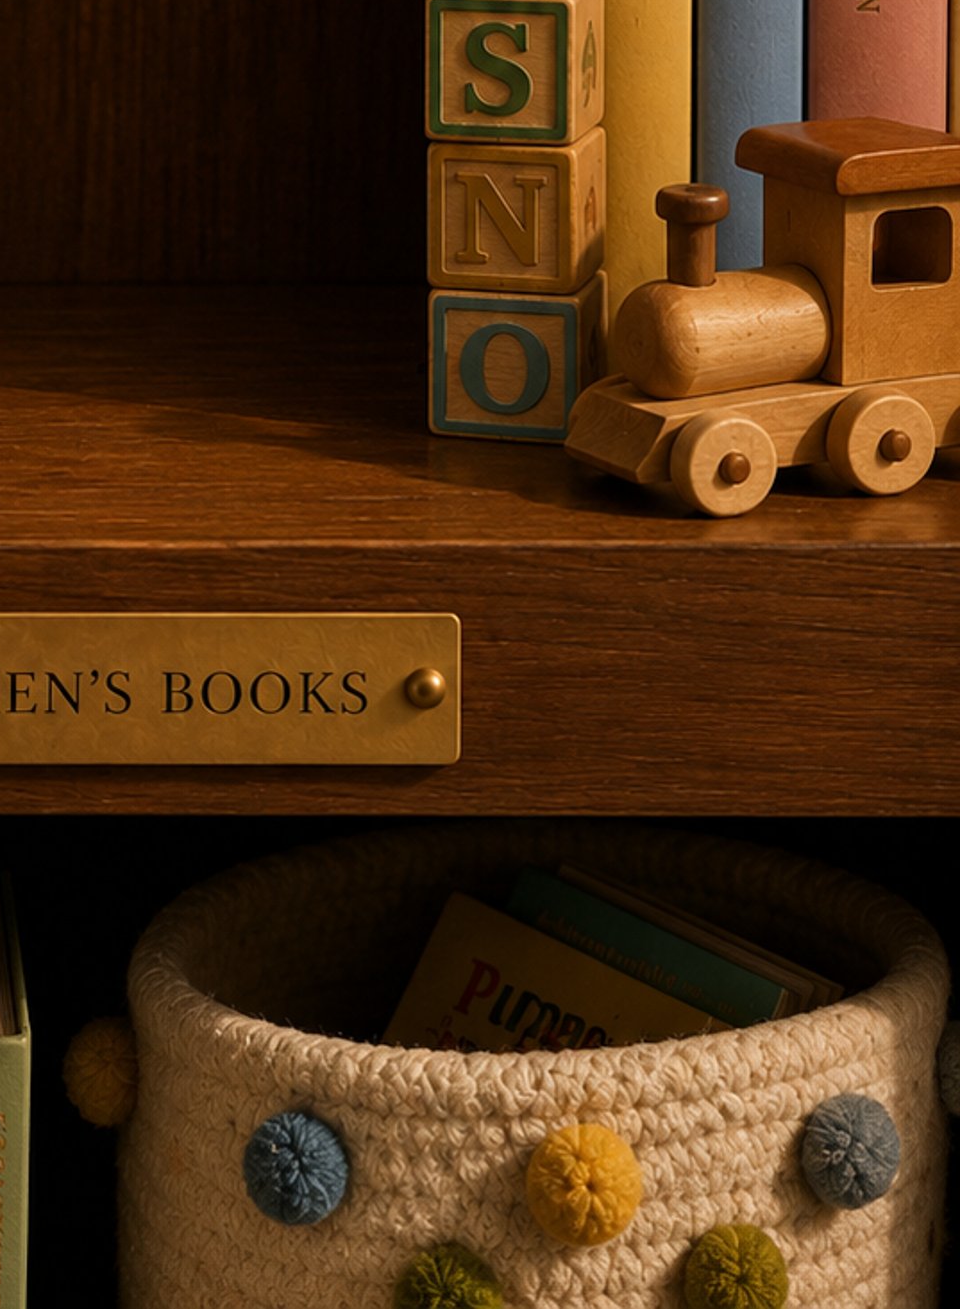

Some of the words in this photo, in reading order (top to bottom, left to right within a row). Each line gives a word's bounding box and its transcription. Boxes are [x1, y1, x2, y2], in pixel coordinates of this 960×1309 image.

[463, 21, 533, 117] S
[453, 171, 548, 267] N
[458, 322, 551, 416] O
[160, 670, 369, 715] BOOKS
